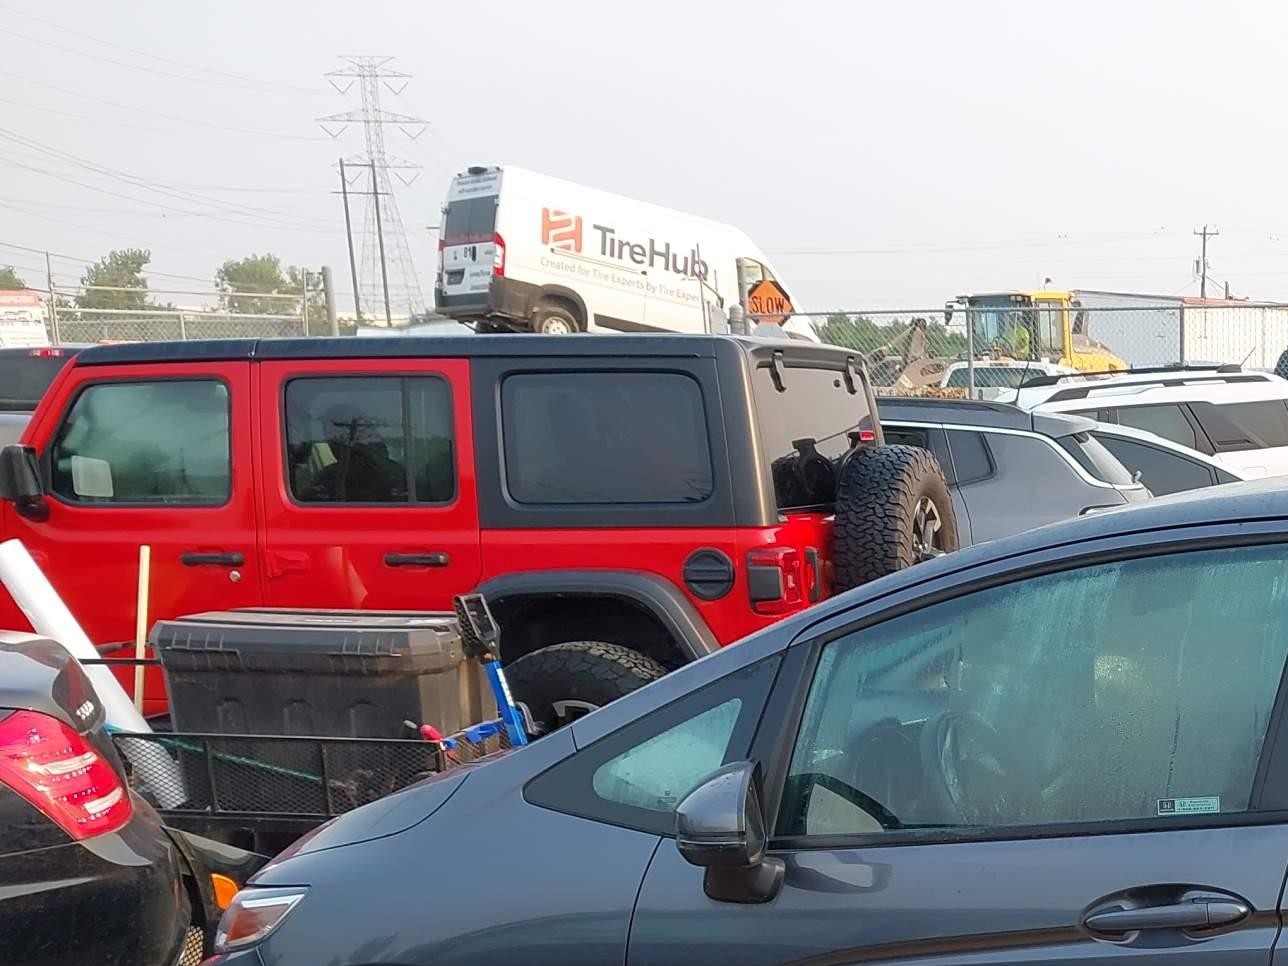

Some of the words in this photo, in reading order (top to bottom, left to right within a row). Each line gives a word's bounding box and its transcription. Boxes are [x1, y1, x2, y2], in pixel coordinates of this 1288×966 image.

[593, 224, 709, 282] TireHub
[540, 256, 577, 273] Created
[578, 262, 591, 278] for
[592, 268, 611, 282] Tire
[611, 273, 646, 290] Experts
[646, 279, 658, 295] by
[658, 283, 676, 298] Tire
[750, 294, 784, 314] SLOW
